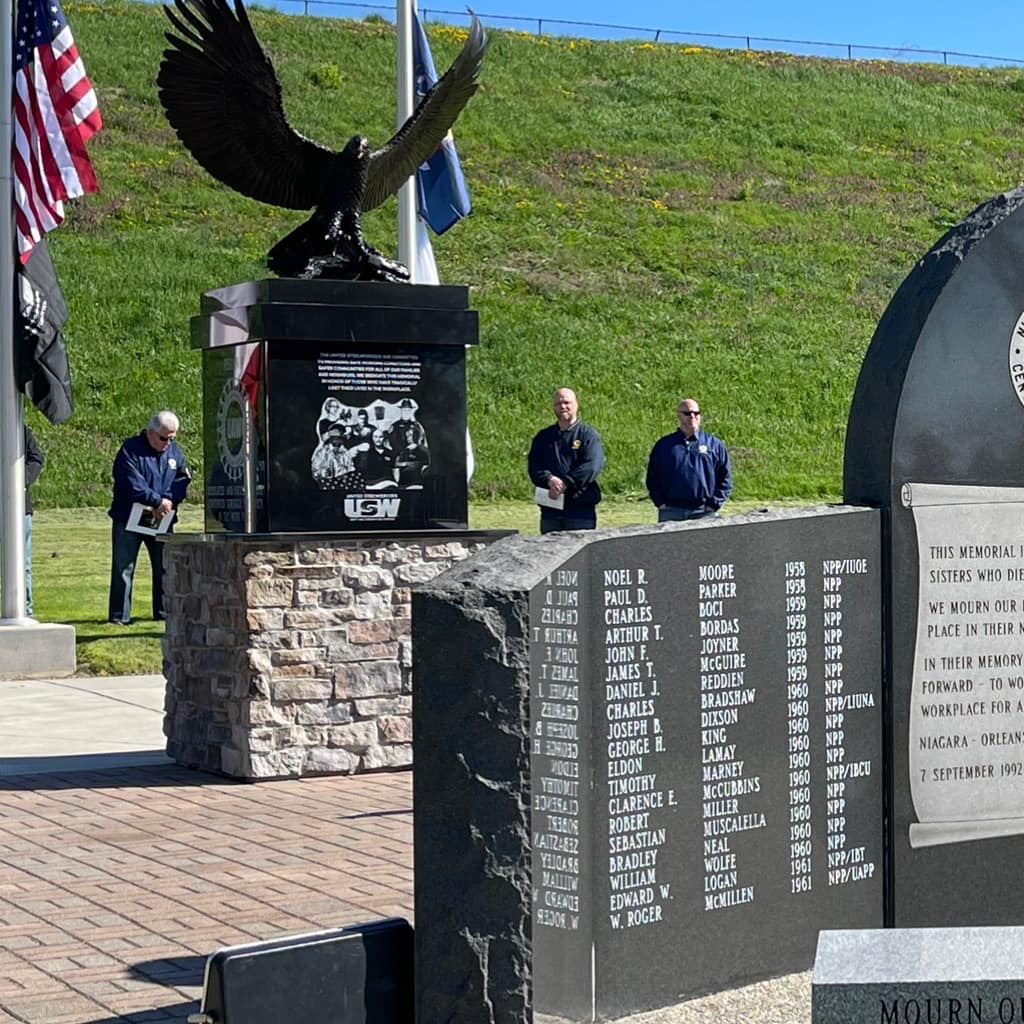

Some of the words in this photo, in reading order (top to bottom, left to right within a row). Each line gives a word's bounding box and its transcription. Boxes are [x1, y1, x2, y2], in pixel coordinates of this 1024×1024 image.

[344, 499, 400, 518] USW
[930, 546, 954, 559] THIS
[960, 545, 1015, 558] MEMORIAL
[604, 570, 633, 585] NOEL
[638, 569, 648, 584] R.
[699, 564, 734, 581] MOORE
[823, 559, 867, 574] NPP/IUOE
[930, 570, 972, 583] SISTERS
[977, 570, 1001, 582] WHO
[604, 590, 632, 605] PAUL
[637, 588, 648, 604] D.
[699, 583, 736, 599] PARKER
[823, 577, 841, 592] NPP
[605, 606, 653, 625] CHARLES
[699, 601, 723, 617] BOCI
[785, 596, 806, 611] 1959
[824, 594, 842, 609] NPP
[929, 601, 944, 614] WE
[951, 601, 989, 614] MOURN
[995, 600, 1016, 613] OUR
[605, 627, 649, 643] ARTHUR
[654, 625, 664, 640] T.
[700, 619, 739, 636] BORDAS
[786, 614, 806, 630] 1959
[824, 611, 842, 626] NPP
[928, 625, 960, 637] PLACE
[966, 624, 977, 636] IN
[983, 623, 1014, 636] THEIR
[924, 658, 936, 671] IN
[941, 656, 973, 670] THEIR
[979, 654, 1023, 668] MEMORY
[922, 680, 973, 694] FORWARD
[990, 678, 1003, 690] TO
[921, 702, 986, 717] WORKPLACE
[992, 701, 1011, 713] FOR
[920, 736, 968, 751] NIAGARA
[921, 769, 926, 782] 7
[933, 766, 994, 781] SEPTEMBER
[1000, 763, 1023, 777] 1992
[881, 998, 983, 1024] MOURN
